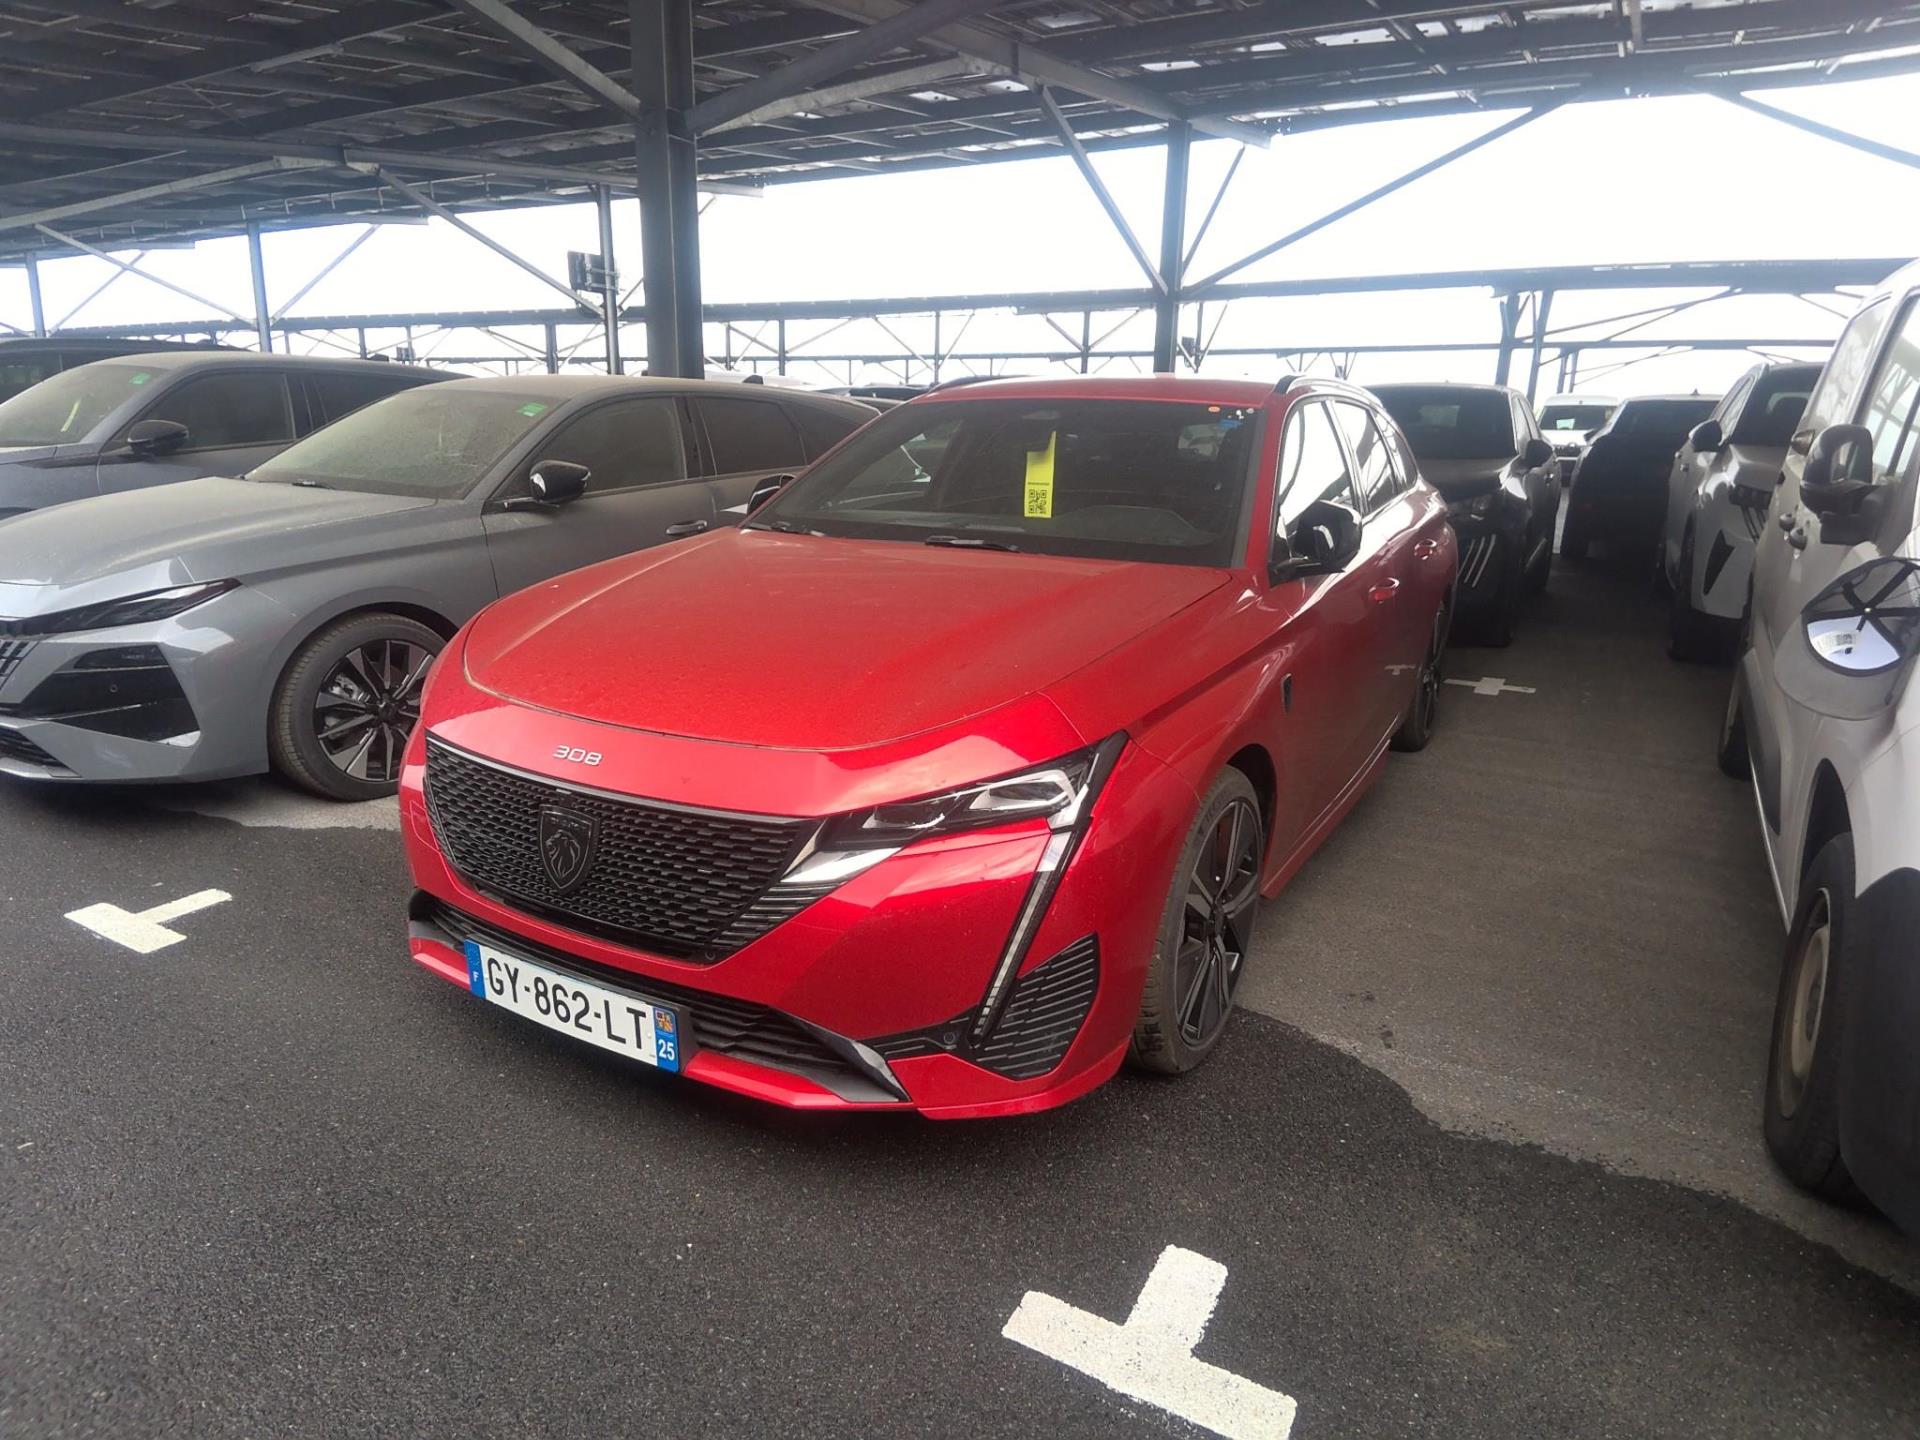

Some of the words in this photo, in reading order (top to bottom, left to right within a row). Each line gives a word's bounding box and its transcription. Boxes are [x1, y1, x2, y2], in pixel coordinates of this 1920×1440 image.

[552, 744, 603, 766] 308
[472, 971, 479, 983] F
[487, 957, 647, 1050] GY-862-LT
[657, 1038, 676, 1061] 25
